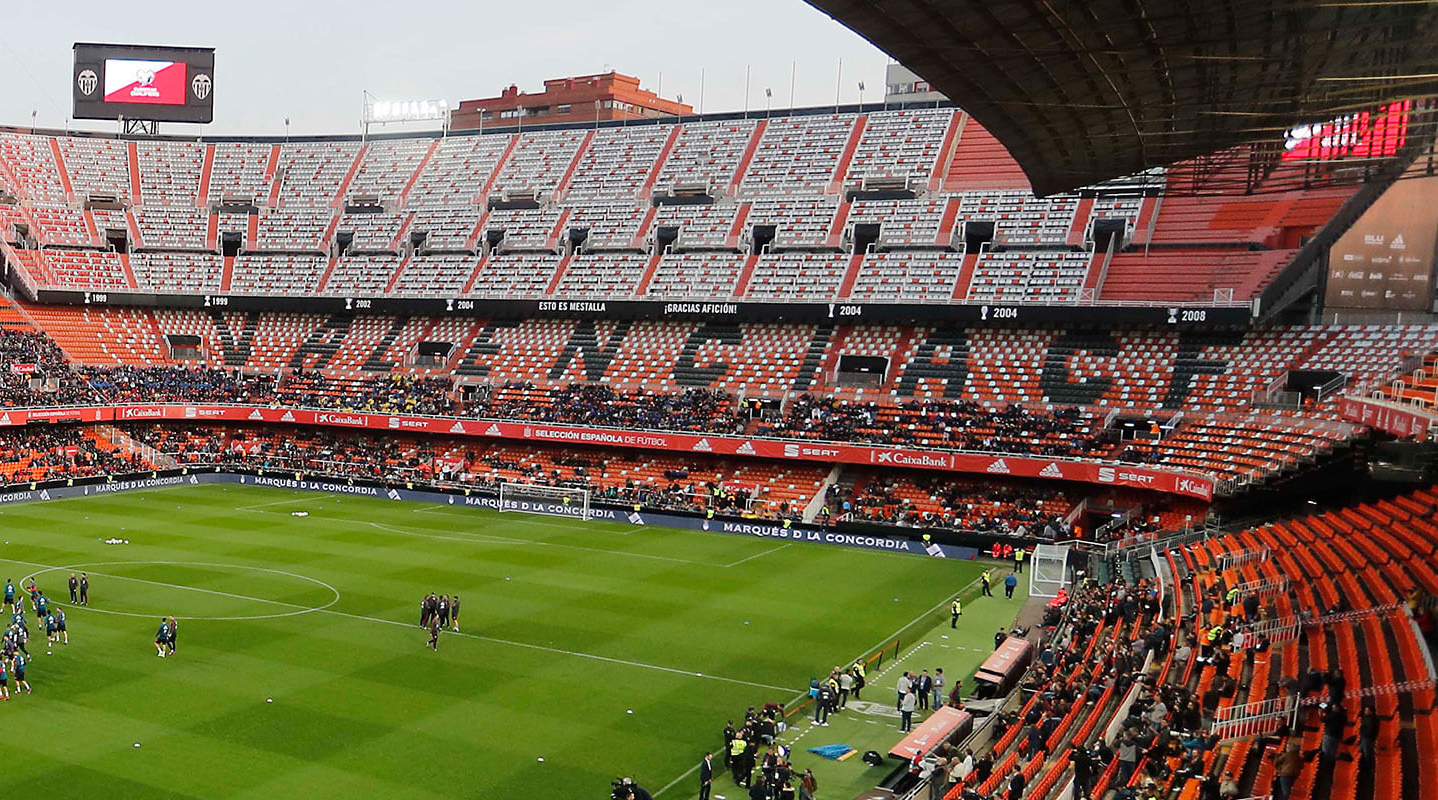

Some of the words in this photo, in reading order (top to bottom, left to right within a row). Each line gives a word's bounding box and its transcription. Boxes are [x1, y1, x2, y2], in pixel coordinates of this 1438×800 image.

[457, 301, 474, 310] 2004
[539, 302, 555, 311] ESTO
[558, 302, 567, 311] ES
[569, 302, 606, 312] MESTALLA
[664, 303, 700, 315] ¡GRACIAS
[701, 302, 737, 314] AFICIÓN!
[840, 305, 862, 316] 2004
[993, 307, 1018, 319] 2004
[1181, 310, 1206, 322] 2008
[134, 409, 162, 417] CaixaBank
[328, 414, 363, 425] CaixaBank
[402, 420, 429, 428] SEAT
[535, 428, 580, 440] SELECCIÓN
[581, 430, 623, 443] ESPAÑOLA
[624, 436, 635, 445] DE
[636, 434, 668, 447] FÚTBOL
[802, 448, 840, 457] SEAT
[893, 453, 947, 467] CaixaBank
[1118, 472, 1155, 484] SEAT
[95, 480, 130, 493] MARQUÉS
[137, 479, 146, 487] LA
[147, 476, 183, 487] CONCORDIA
[254, 476, 298, 489] MARQUÉS
[310, 482, 320, 490] LA
[322, 483, 378, 496] CONCORDIA
[532, 502, 545, 512] LA
[723, 523, 788, 539] MARQUÉS
[807, 530, 822, 541] LA
[825, 533, 910, 550] CONCORDIA
